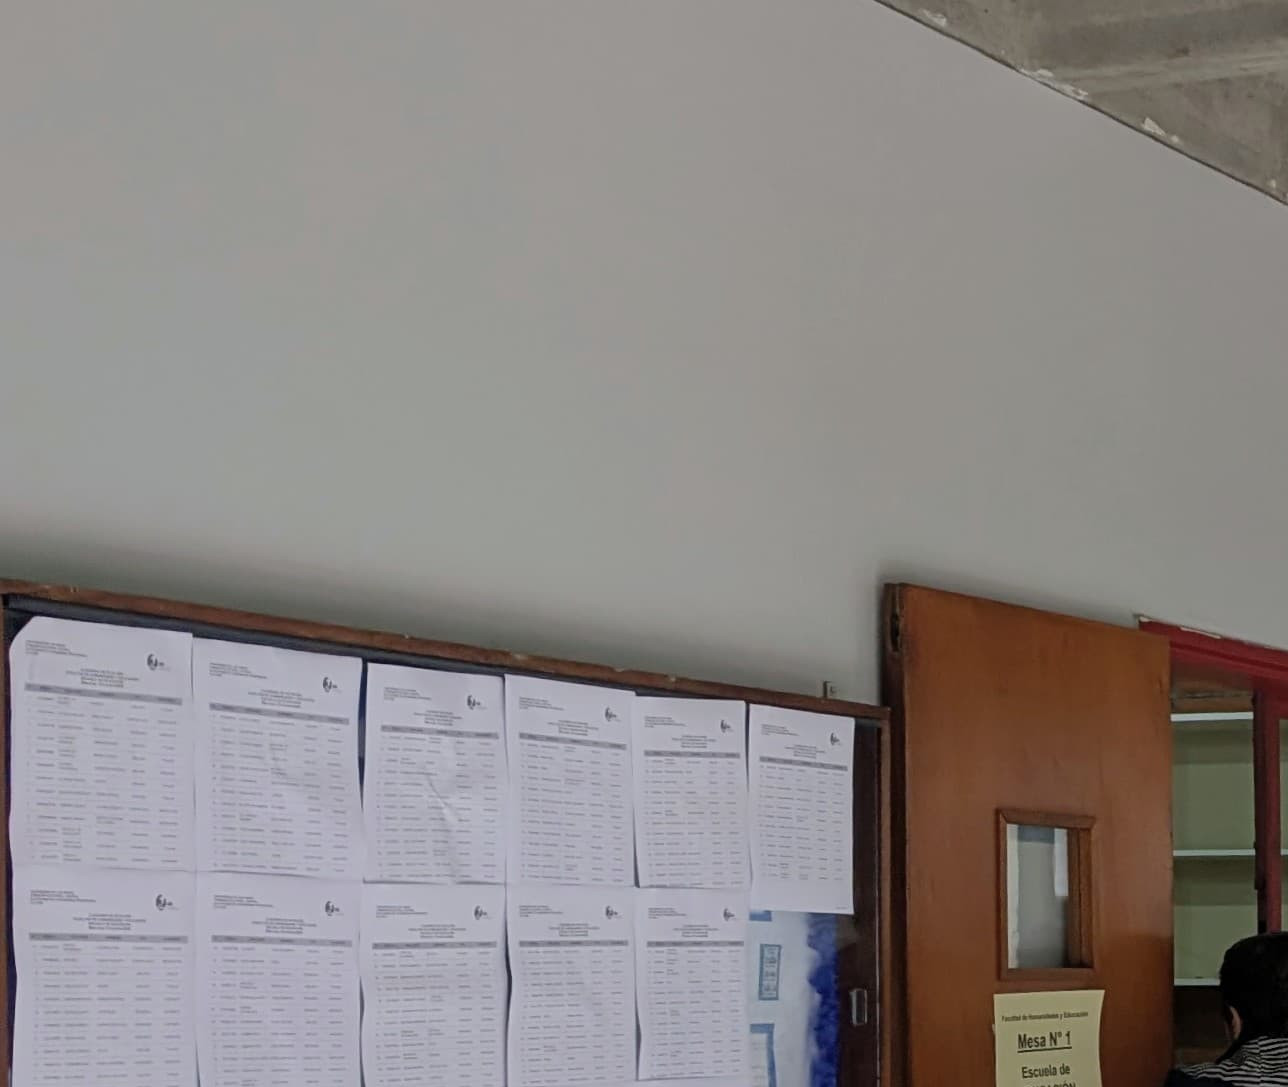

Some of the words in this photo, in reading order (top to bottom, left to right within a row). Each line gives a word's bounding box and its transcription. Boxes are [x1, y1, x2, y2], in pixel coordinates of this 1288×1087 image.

[1018, 1033, 1046, 1049] Mesa
[1065, 1030, 1071, 1045] 1
[1022, 1064, 1057, 1079] Escuela
[1060, 1063, 1070, 1075] de
